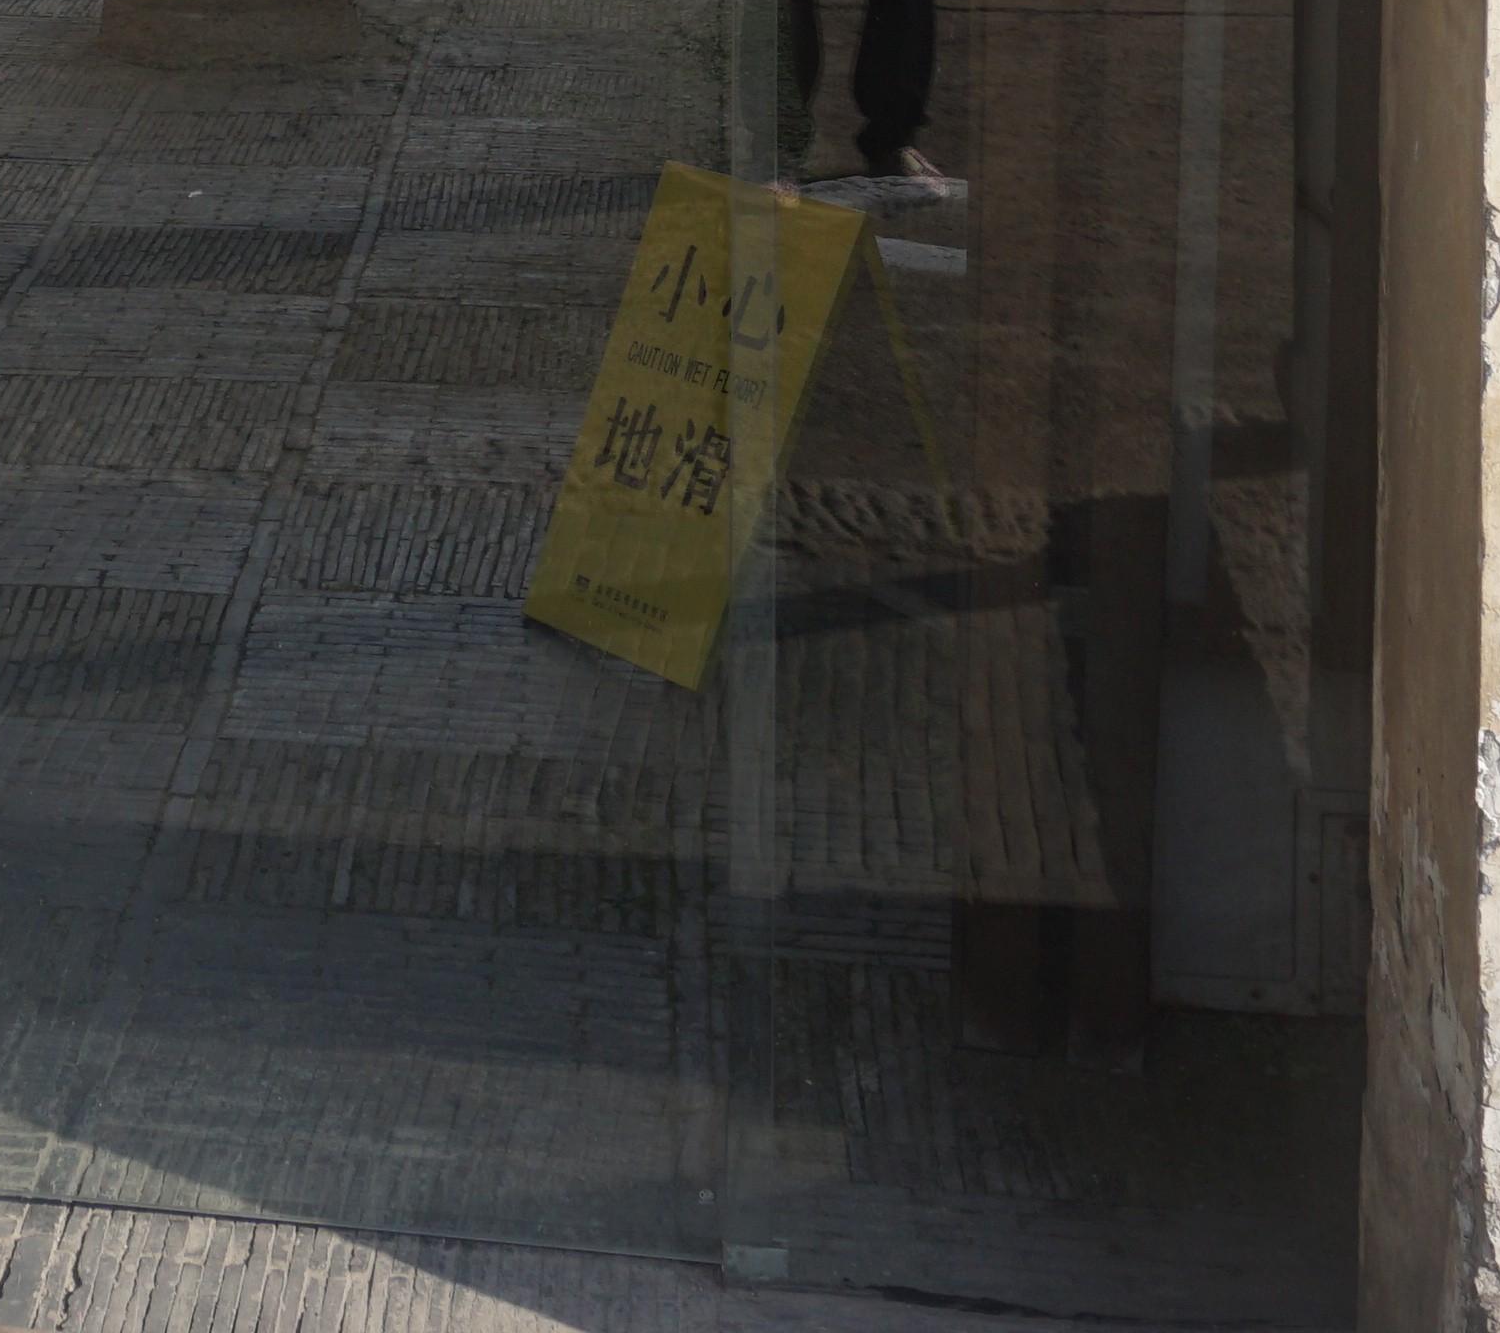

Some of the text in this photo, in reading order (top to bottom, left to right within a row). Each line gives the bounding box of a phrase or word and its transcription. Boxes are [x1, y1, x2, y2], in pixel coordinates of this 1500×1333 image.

[651, 244, 785, 351] 小心
[627, 340, 684, 378] CAUTION
[683, 361, 713, 385] WET
[594, 396, 731, 516] 地滑
